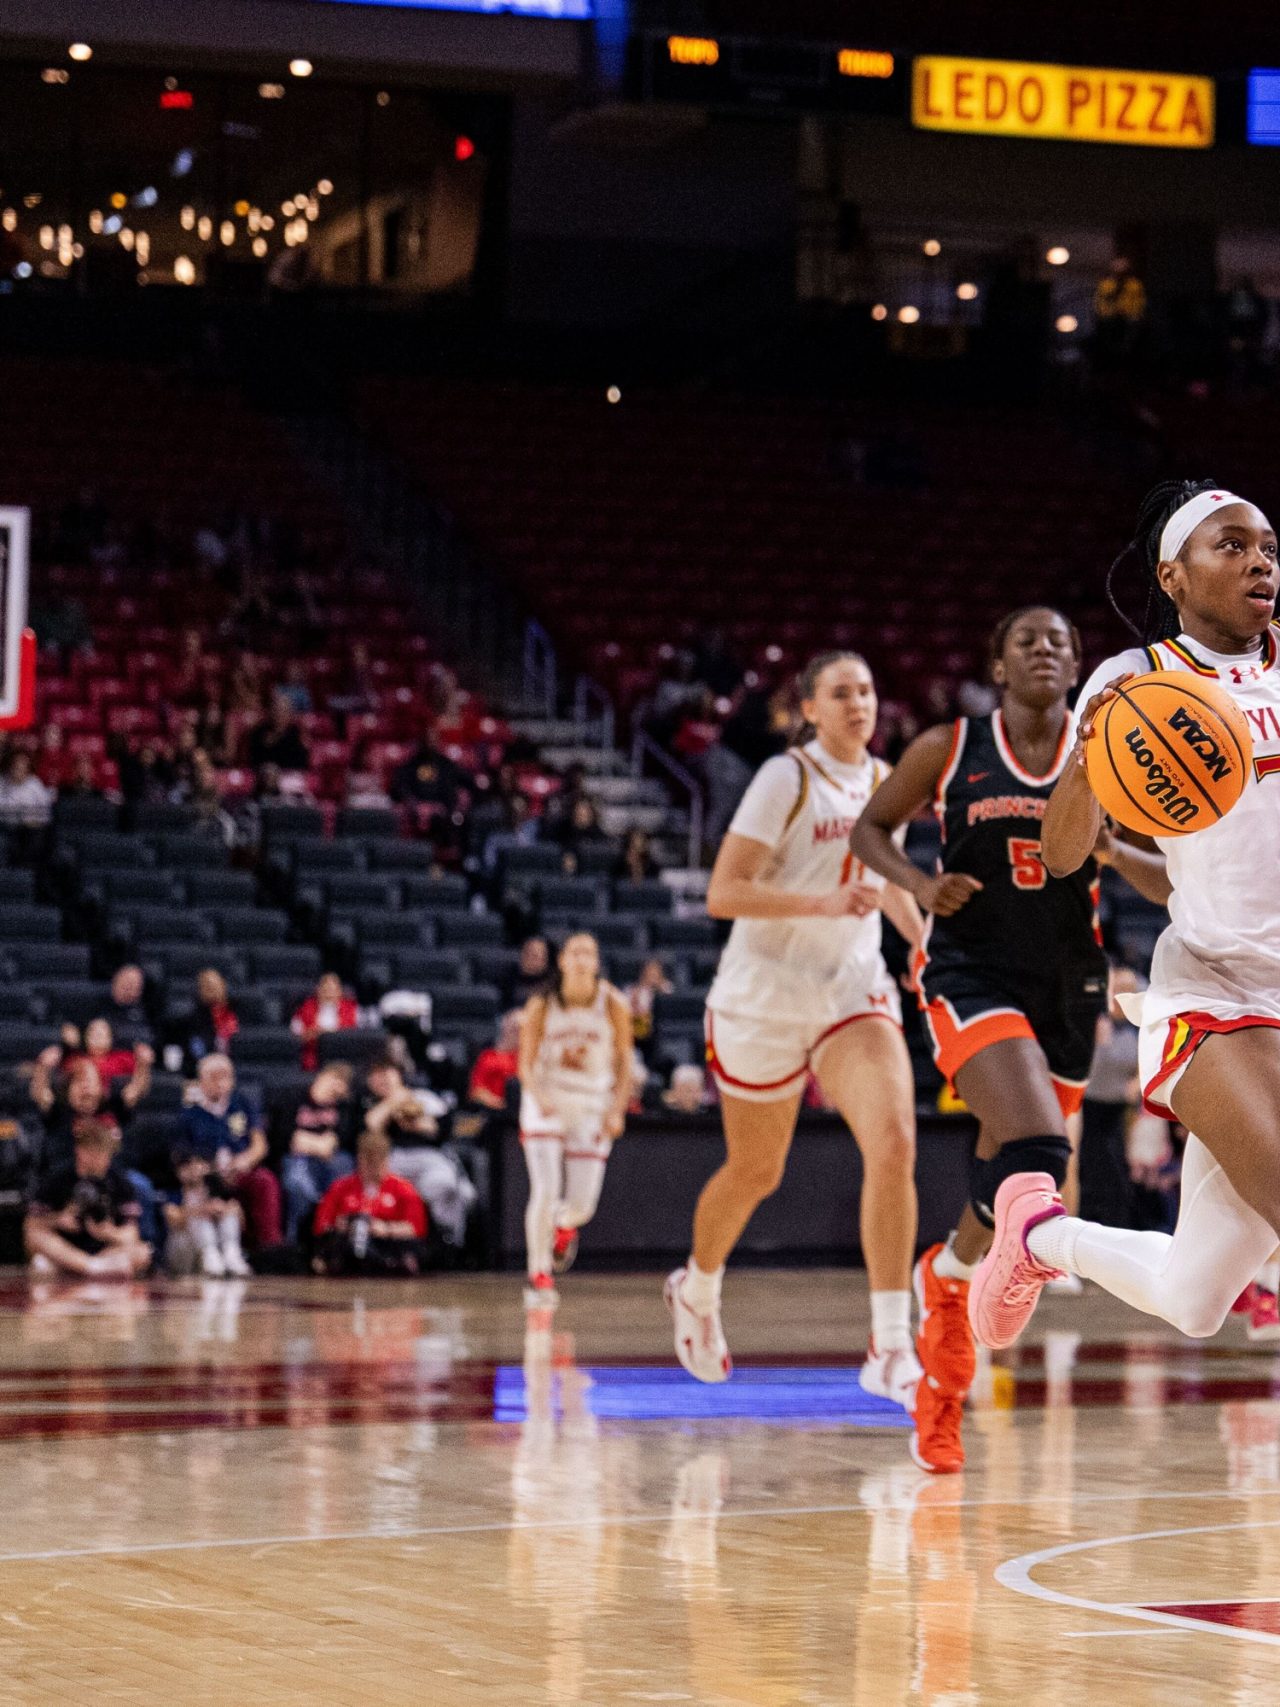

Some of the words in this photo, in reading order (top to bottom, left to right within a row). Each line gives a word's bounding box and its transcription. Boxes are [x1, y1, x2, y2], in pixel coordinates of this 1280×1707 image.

[923, 69, 1044, 124] LEDO
[1066, 79, 1205, 137] PIZZA
[1124, 726, 1200, 826] Wilson
[1167, 706, 1233, 783] NCAA
[1007, 837, 1048, 890] 5
